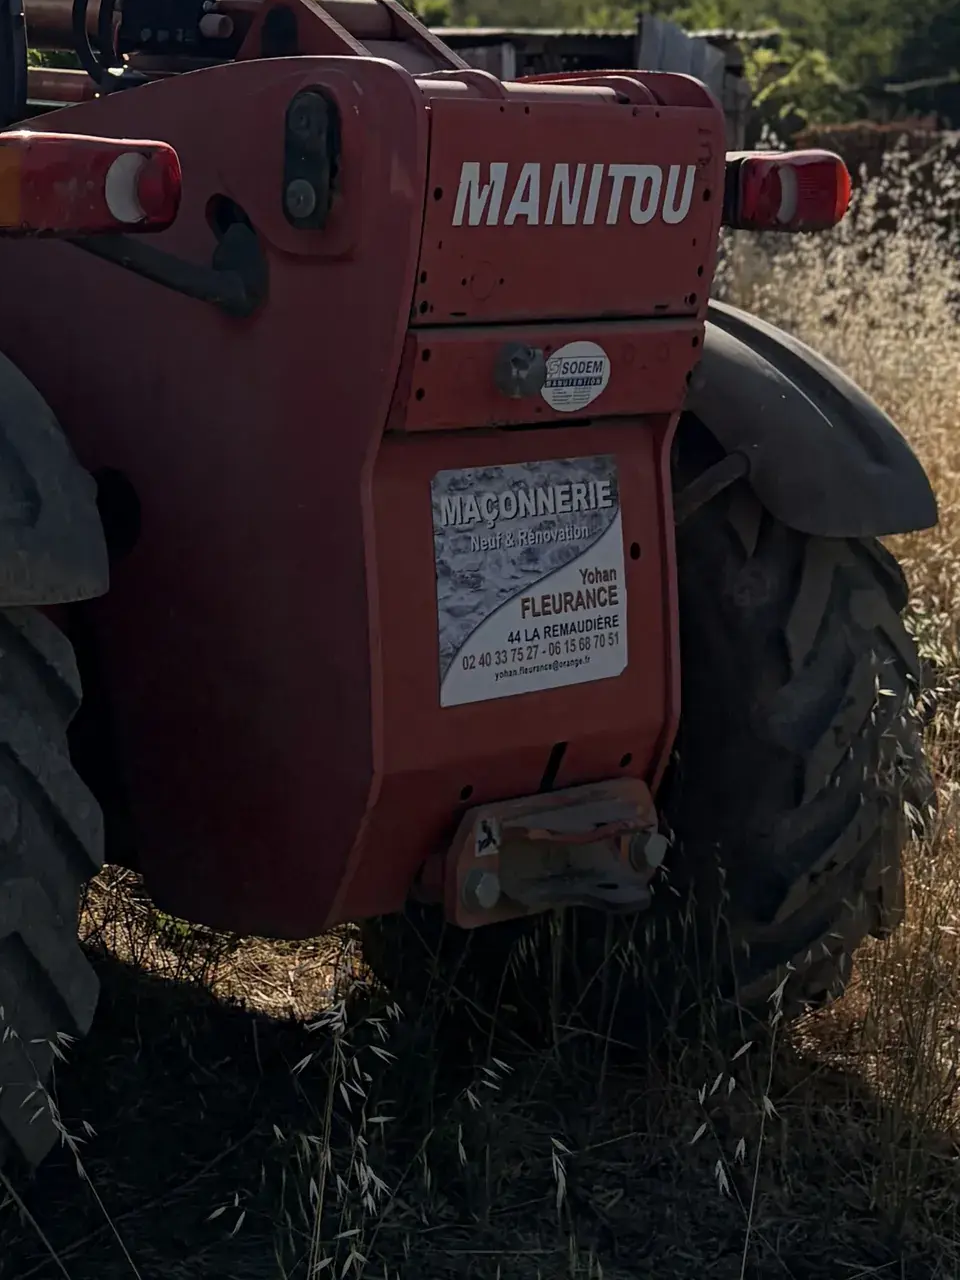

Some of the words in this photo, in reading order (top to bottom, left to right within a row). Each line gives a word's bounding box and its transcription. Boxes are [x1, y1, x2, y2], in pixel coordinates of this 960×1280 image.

[451, 161, 697, 227] MANITOU
[562, 360, 603, 375] SODEM
[440, 480, 614, 529] MAÇONNERIE
[470, 532, 502, 552] Neuf
[505, 532, 516, 548] &
[518, 525, 589, 547] Rénovation
[579, 567, 617, 585] Yohan
[520, 585, 619, 620] FLEURANCE
[508, 631, 522, 644] 44
[525, 629, 540, 642] LA
[543, 615, 620, 639] REMAUDIÈRE
[462, 655, 476, 670] 02
[478, 652, 491, 667] 40
[495, 650, 508, 665] 33
[511, 647, 523, 662] 75
[526, 645, 539, 660] 27
[548, 642, 561, 657] 06
[565, 638, 576, 653] 15
[579, 635, 591, 651] 68
[594, 633, 606, 649] 70
[608, 632, 620, 646] 51
[494, 655, 592, 681] yohan.fleurance@orange.fr
